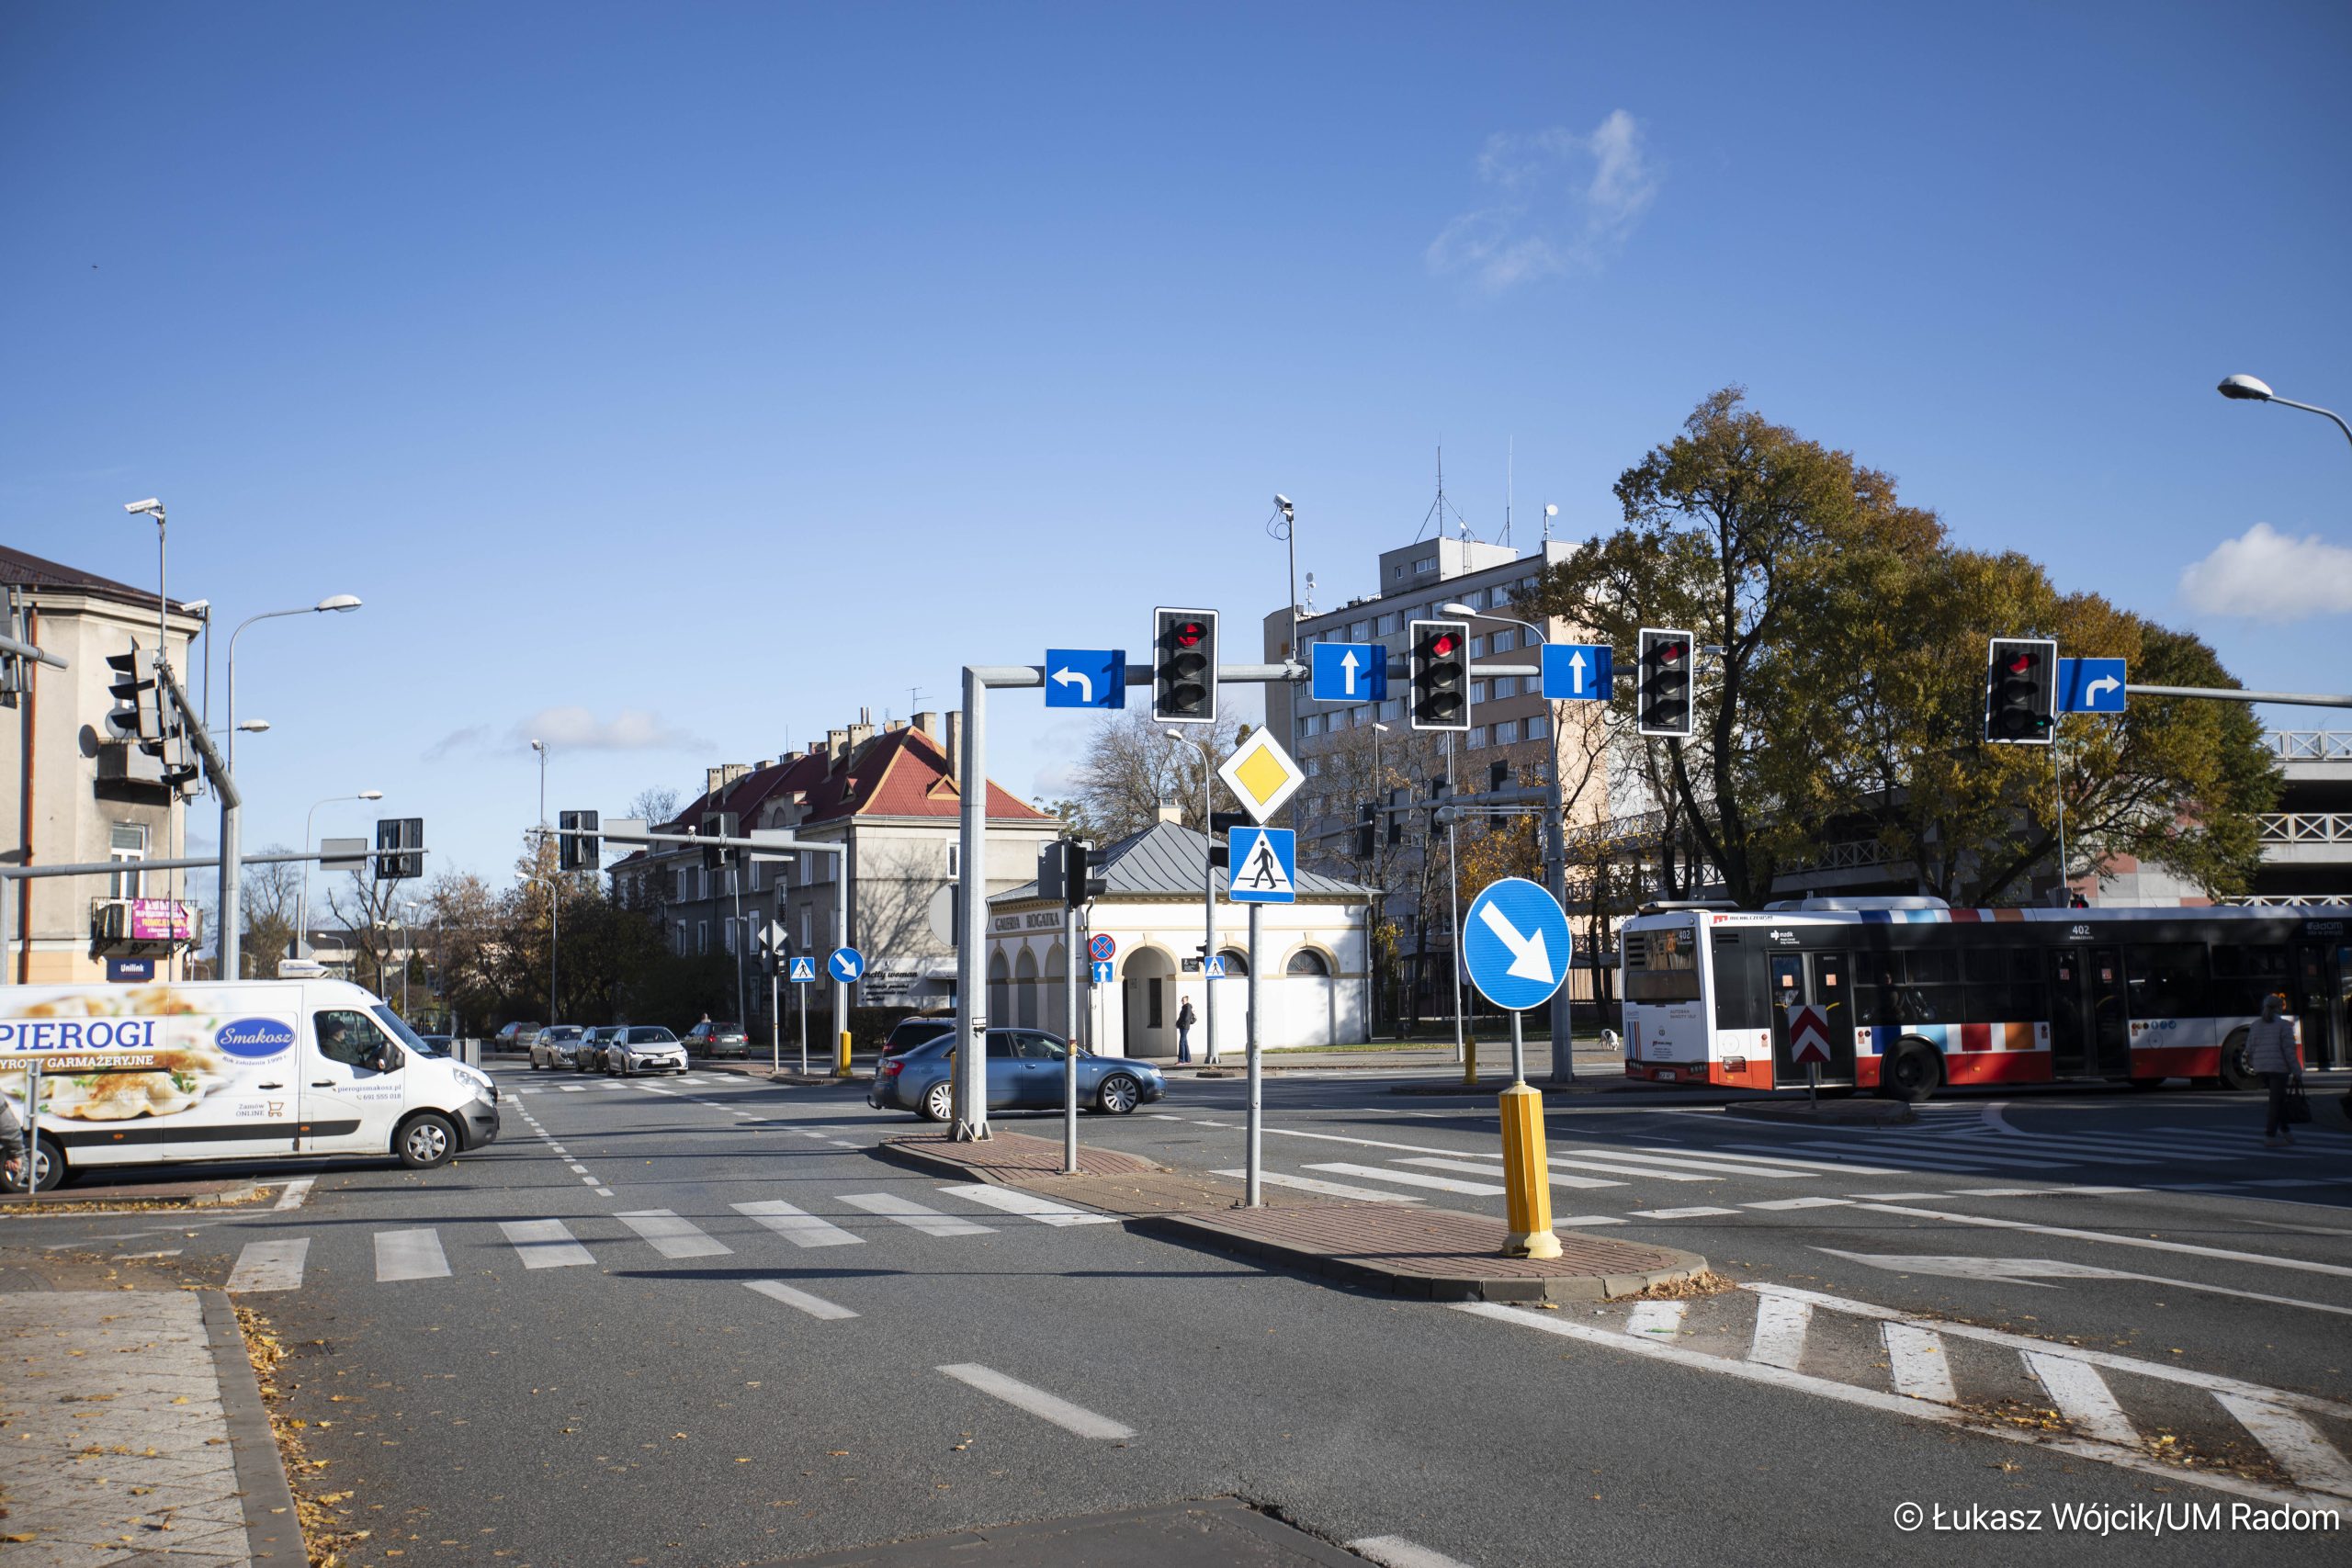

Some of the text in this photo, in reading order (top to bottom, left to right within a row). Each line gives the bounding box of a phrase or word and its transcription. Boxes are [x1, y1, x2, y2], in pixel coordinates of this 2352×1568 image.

[1026, 912, 1059, 928] ROGATKA
[1679, 930, 1690, 940] 402
[2073, 926, 2090, 934] 402
[120, 964, 144, 973] Unilink
[220, 1028, 293, 1045] Smakosz
[47, 1055, 153, 1068] GARMAŻERYJNE
[337, 1085, 401, 1093] pierogismakosz.pl
